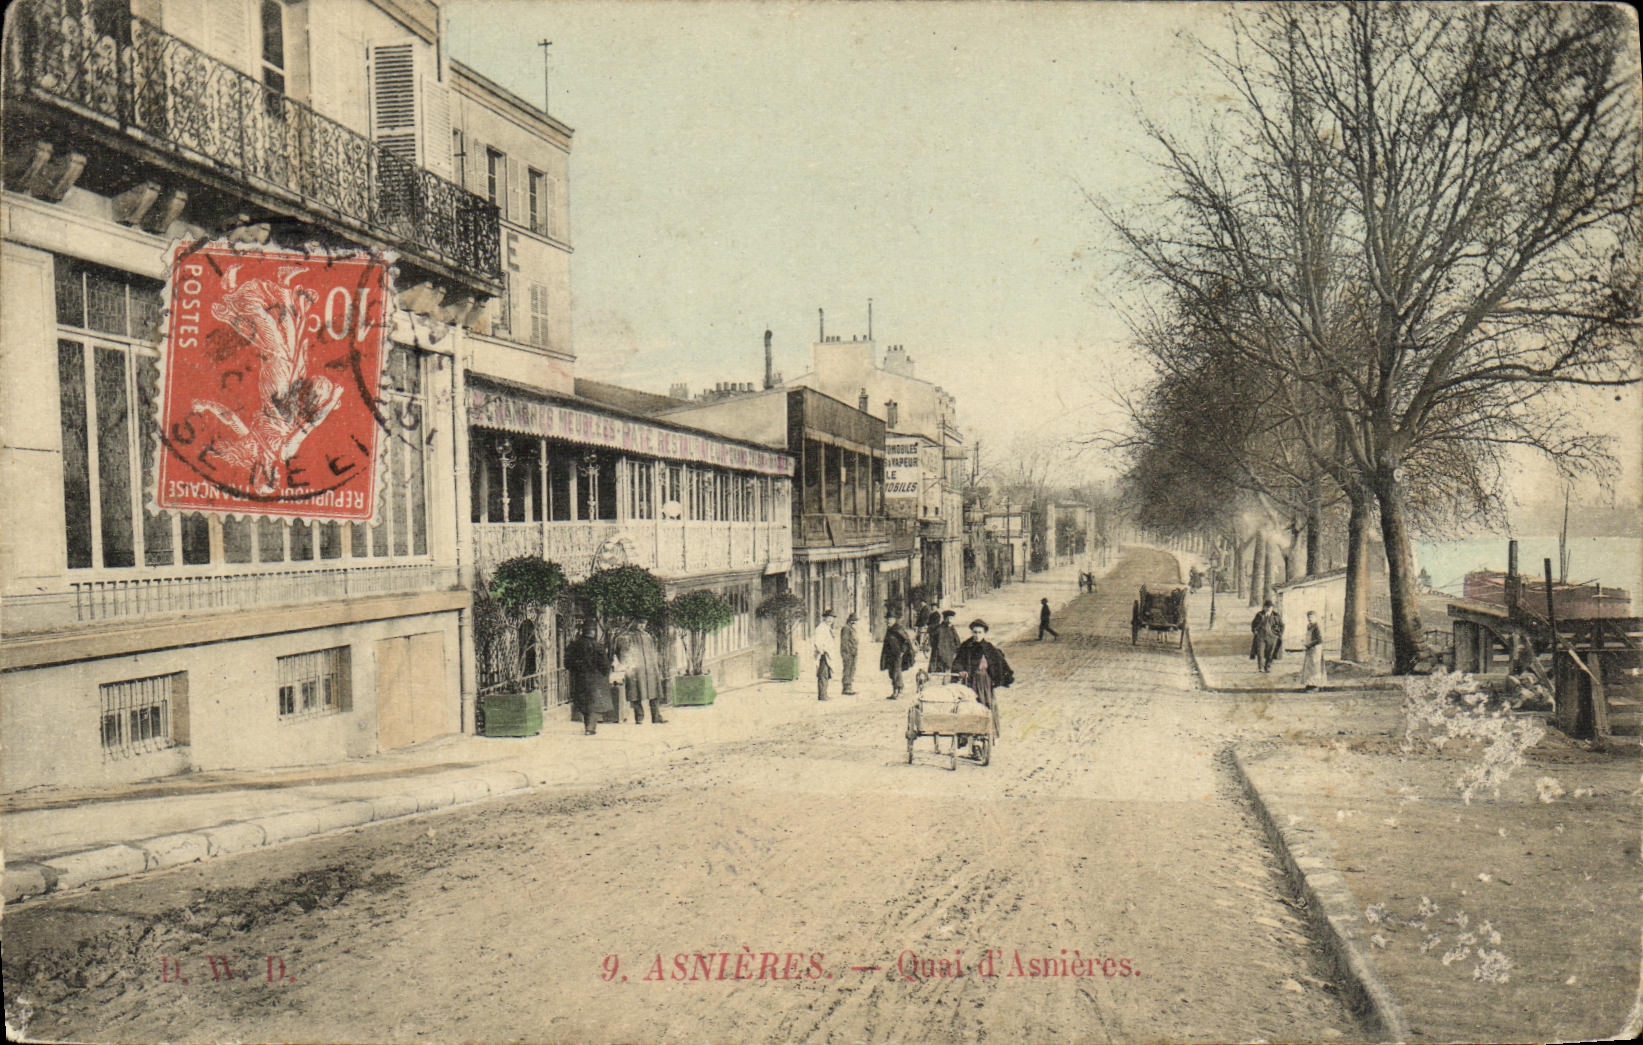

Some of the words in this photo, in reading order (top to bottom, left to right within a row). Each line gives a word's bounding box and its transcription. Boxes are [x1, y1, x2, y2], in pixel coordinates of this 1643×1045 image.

[178, 264, 204, 349] POSTES
[324, 285, 377, 343] 10
[891, 457, 919, 468] VAPEUR
[168, 479, 250, 502] FRANÇAISE
